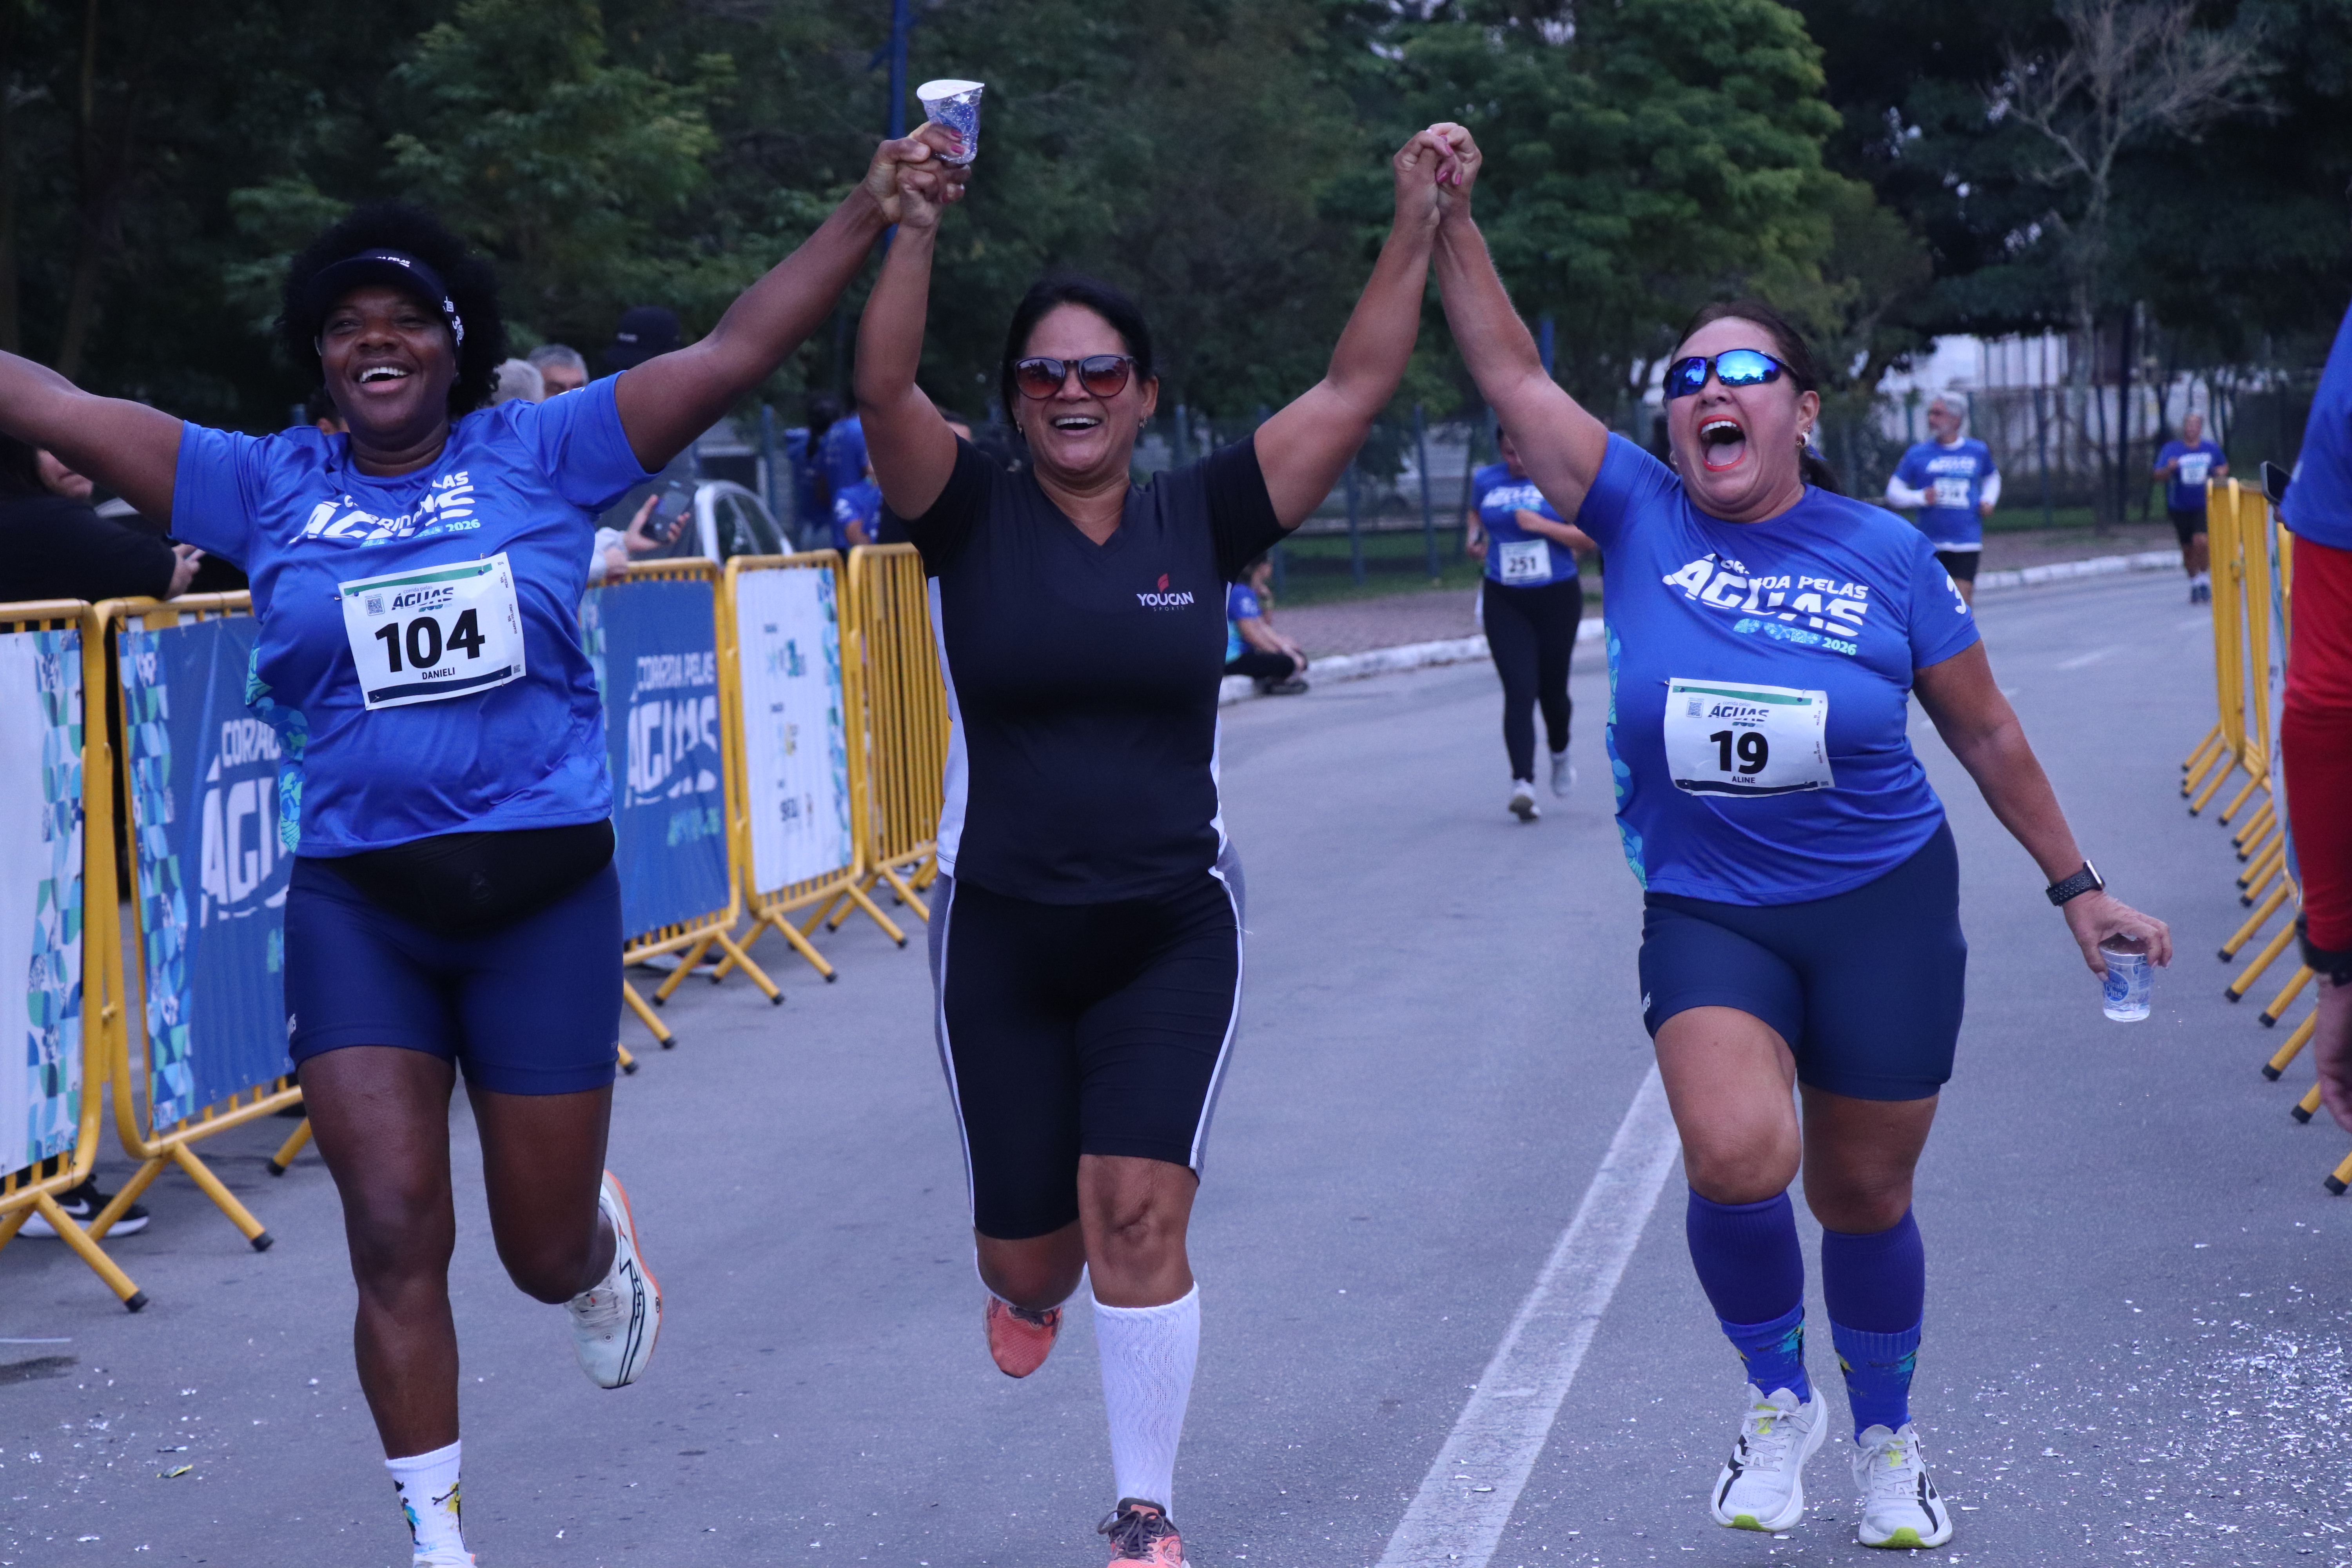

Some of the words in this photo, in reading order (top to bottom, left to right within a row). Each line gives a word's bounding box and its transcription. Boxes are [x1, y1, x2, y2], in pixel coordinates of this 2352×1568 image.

[445, 519, 481, 532] 2026
[1508, 556, 1536, 573] 251
[1797, 575, 1869, 599] PELAS
[391, 586, 454, 611] ÁGUAS
[1136, 591, 1194, 606] YOUCAN
[375, 608, 485, 673] 104
[1822, 637, 1857, 655] 2026
[422, 667, 456, 680] DANIELI
[1708, 702, 1769, 722] ÁGUAS
[1710, 730, 1769, 775] 19
